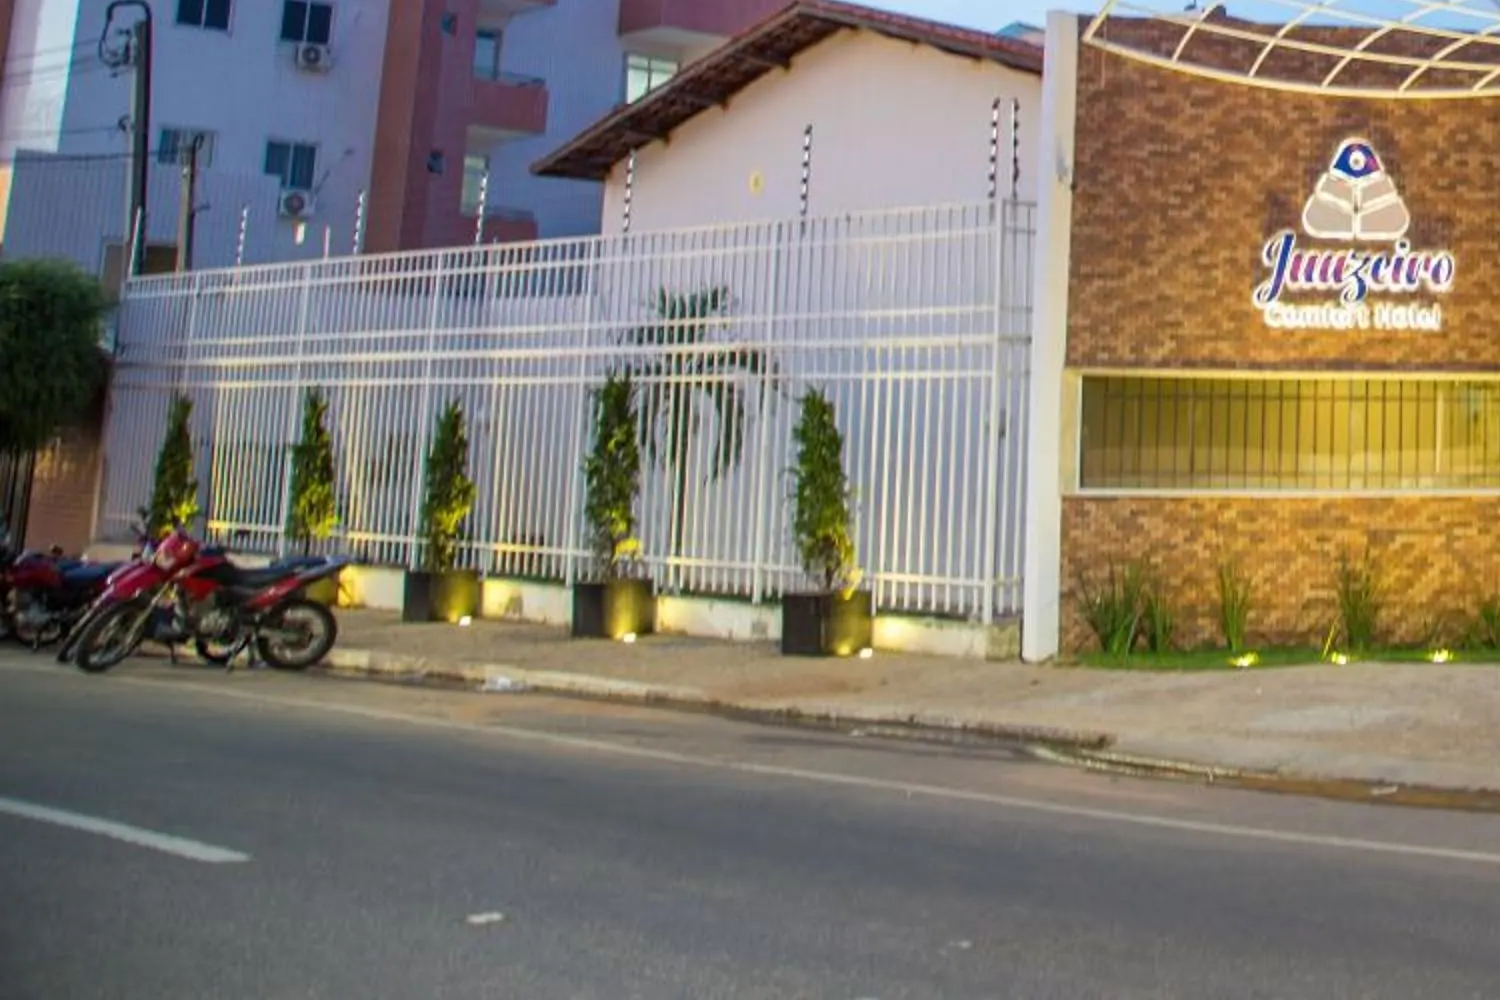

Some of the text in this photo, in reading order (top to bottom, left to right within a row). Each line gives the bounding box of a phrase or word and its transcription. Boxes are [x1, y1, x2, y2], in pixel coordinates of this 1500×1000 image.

[1254, 230, 1454, 307] Juazeiro
[1264, 302, 1441, 330] Comfort Hotel
